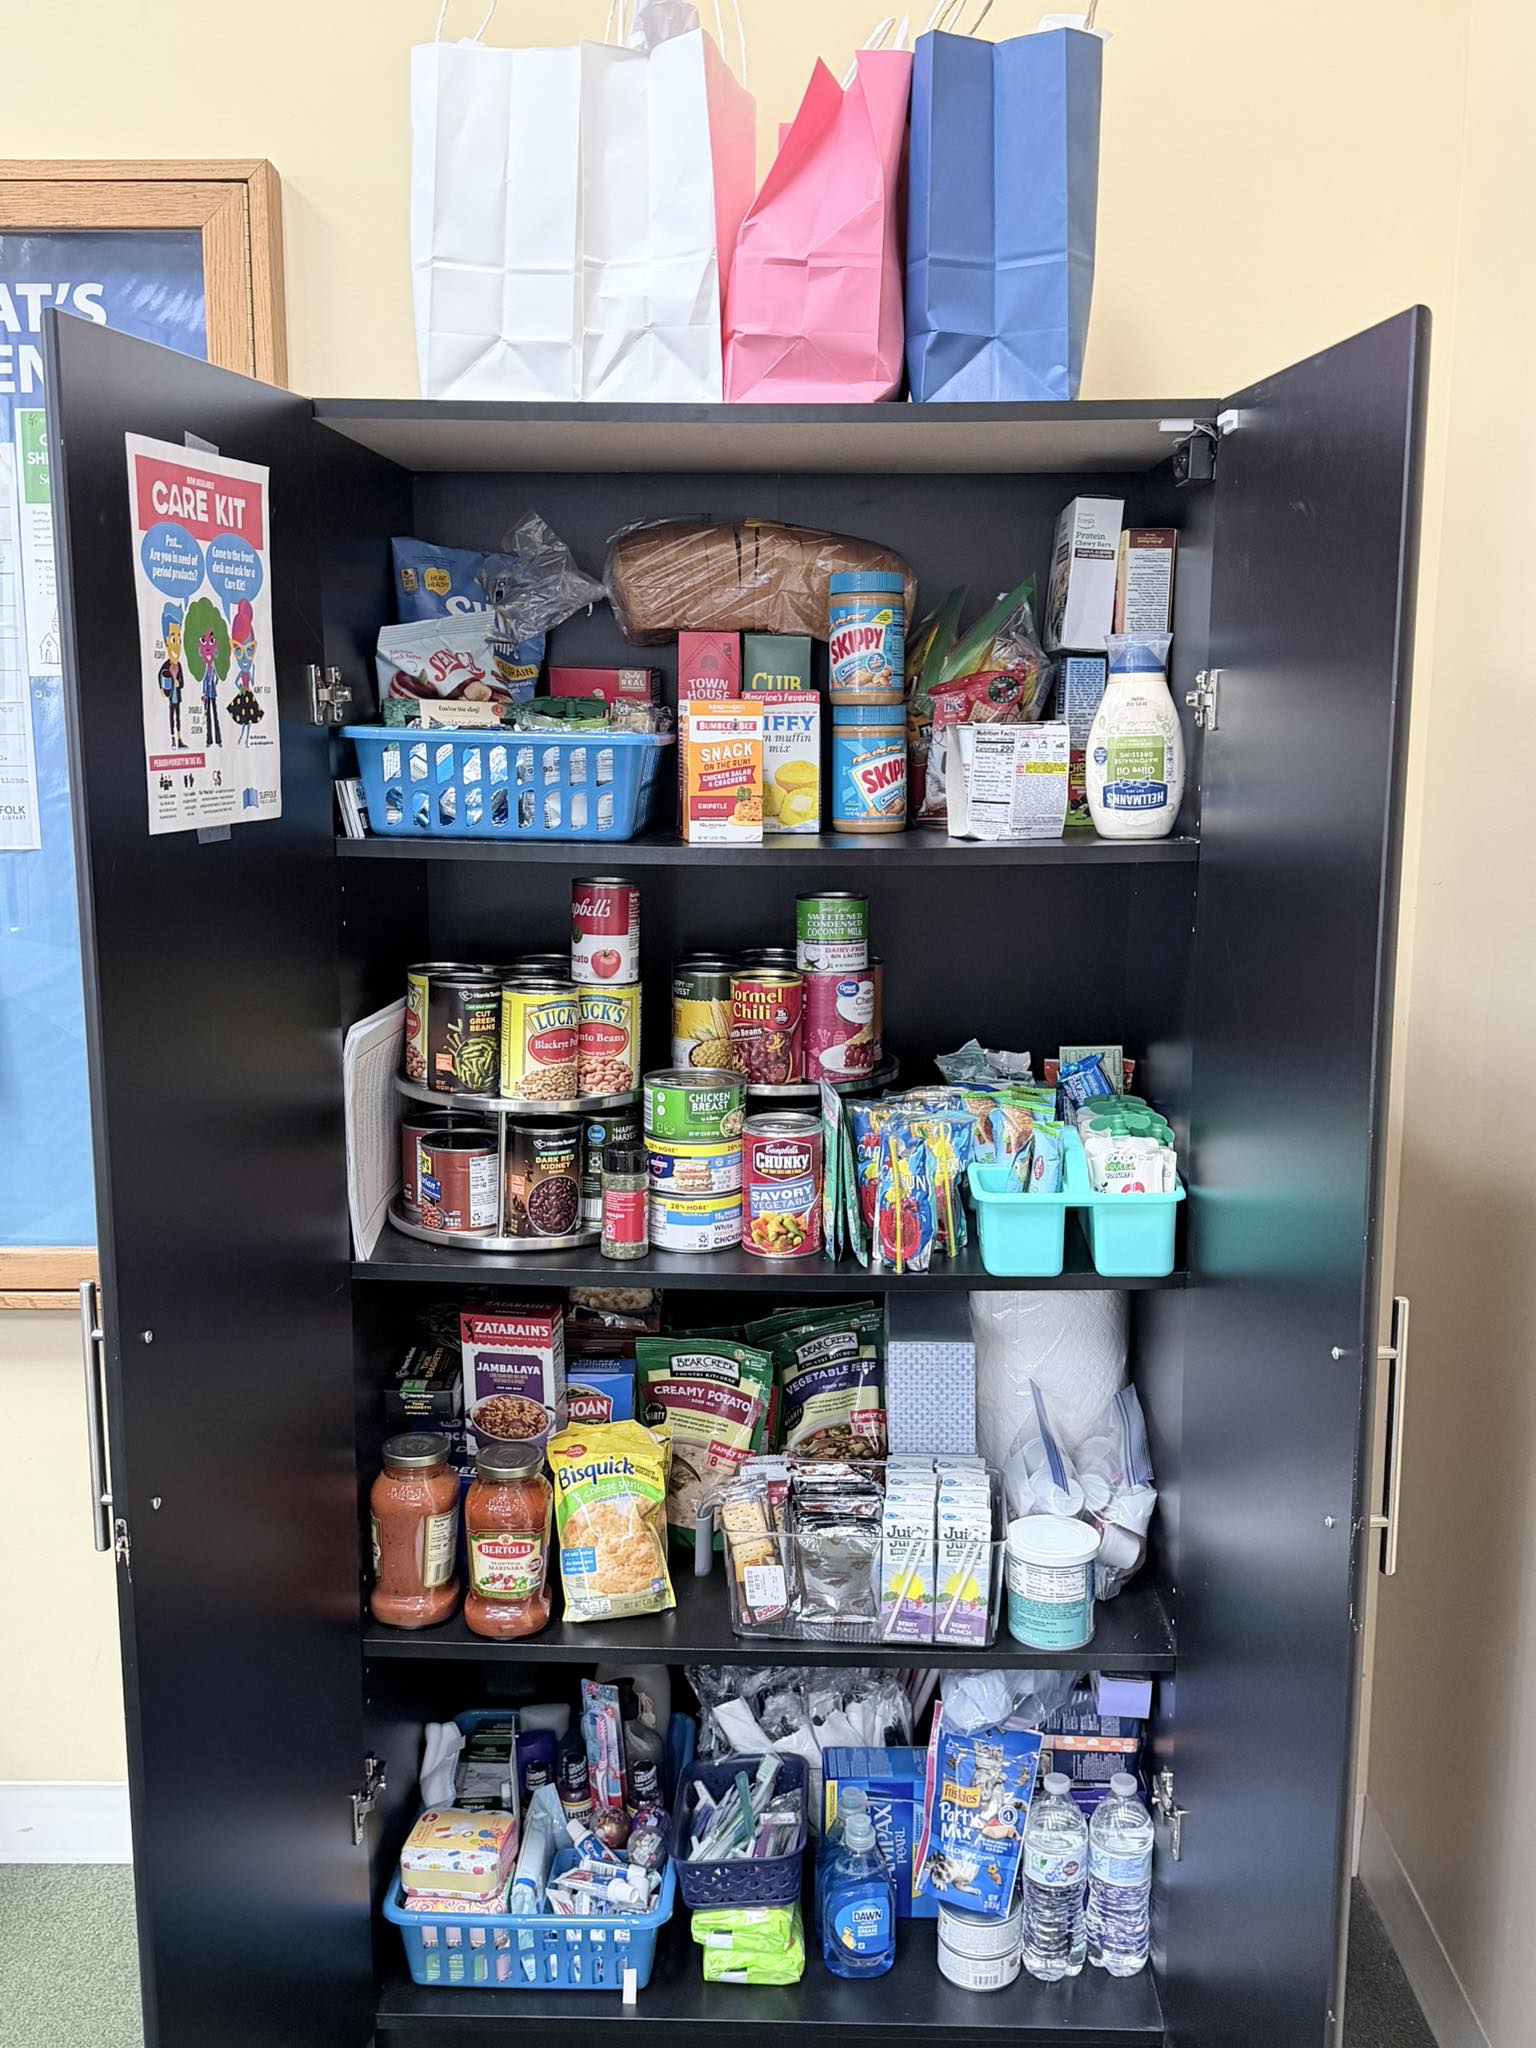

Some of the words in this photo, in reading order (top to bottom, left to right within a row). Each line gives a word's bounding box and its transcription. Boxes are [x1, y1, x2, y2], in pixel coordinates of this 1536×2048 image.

[152, 480, 209, 523] CARE
[215, 493, 246, 529] KIT
[1075, 531, 1106, 541] Protein
[1075, 540, 1096, 548] Chewy
[150, 548, 161, 561] Are
[161, 551, 172, 565] you
[177, 553, 191, 565] need
[191, 555, 198, 566] of
[212, 546, 226, 560] Come
[240, 551, 254, 564] front
[152, 565, 172, 582] period
[172, 568, 198, 585] products?
[212, 562, 224, 574] desk
[224, 564, 235, 576] and
[831, 627, 882, 665] SKIPPY
[688, 678, 729, 691] TOWN
[687, 689, 730, 700] HOUSE
[783, 692, 816, 702] Favorite
[699, 722, 732, 731] BUMBLE
[739, 722, 754, 731] BEE
[775, 733, 811, 744] muffin
[700, 742, 753, 763] SNACK
[768, 744, 791, 753] mix
[704, 762, 715, 771] ON
[716, 760, 732, 770] THE
[1116, 766, 1130, 776] Oil
[1132, 766, 1155, 776] Olive
[702, 771, 730, 782] CHICKEN
[731, 767, 751, 778] SALAD
[714, 777, 747, 787] CRACKERS
[807, 912, 863, 921] SWEETENED
[807, 919, 863, 928] CONDENSED
[807, 927, 845, 937] COCONUT
[475, 1010, 491, 1018] CUT
[733, 1002, 771, 1020] Chili
[469, 1016, 496, 1025] GREEN
[469, 1023, 496, 1032] BEANS
[740, 1028, 763, 1037] Beans
[534, 1039, 569, 1050] Blackeye
[595, 1033, 625, 1043] Beans
[689, 1091, 731, 1105] CHICKEN
[691, 1099, 728, 1112] BREAST
[765, 1143, 799, 1154] Campbell's
[535, 1156, 559, 1164] DARK
[560, 1153, 575, 1162] RED
[756, 1152, 810, 1170] CHUNKY
[541, 1161, 571, 1170] KIDNEY
[751, 1184, 812, 1201] SAVORY
[670, 1202, 685, 1210] 28%
[752, 1193, 814, 1210] VEGETABLE
[714, 1223, 734, 1231] White
[714, 1232, 742, 1245] CHICKEN
[474, 1321, 550, 1338] ZATARAIN'S
[799, 1340, 824, 1358] BEAR
[823, 1334, 855, 1349] CREEK
[476, 1361, 541, 1377] JAMBALAYA
[676, 1357, 702, 1368] BEAR
[702, 1357, 736, 1373] CREEK
[785, 1364, 849, 1396] VEGETABLE
[654, 1386, 705, 1397] CREAMY
[708, 1390, 751, 1412] POTATO
[567, 1399, 608, 1418] HOAN
[712, 1444, 737, 1458] FAMILY
[557, 1455, 636, 1491] Bisquick
[583, 1482, 617, 1496] cheese
[481, 1544, 532, 1555] BERTOLLI
[896, 1626, 919, 1635] PUNCH
[949, 1628, 972, 1637] PUNCH
[943, 1782, 979, 1804] friskies
[938, 1801, 982, 1825] Party
[940, 1821, 973, 1843] Mix
[853, 1909, 882, 1922] DAWN
